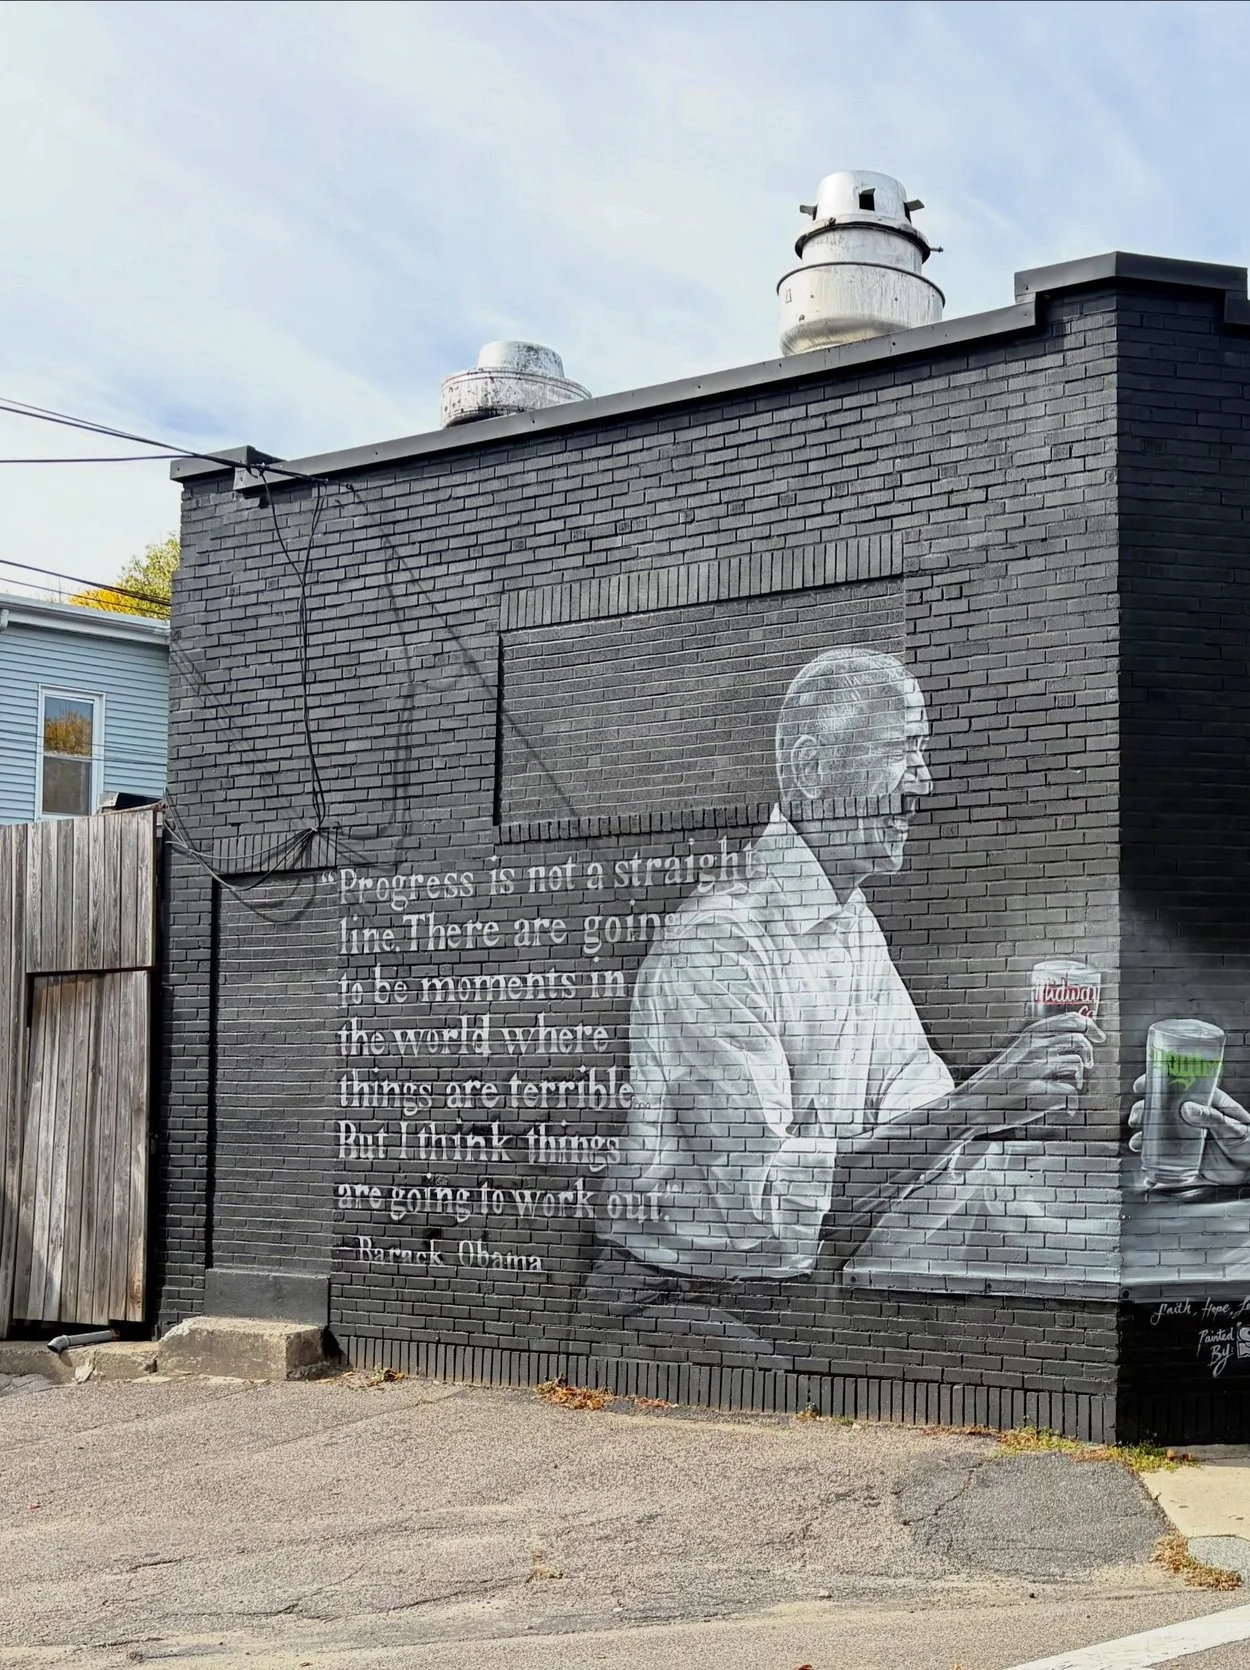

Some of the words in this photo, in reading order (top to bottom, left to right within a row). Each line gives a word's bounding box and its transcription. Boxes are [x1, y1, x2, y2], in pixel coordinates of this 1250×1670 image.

[489, 855, 516, 895] is
[527, 855, 576, 891] not
[585, 861, 605, 890] a
[614, 834, 757, 894] straight
[513, 918, 568, 947] are
[581, 900, 682, 954] going
[337, 971, 363, 1010] to
[374, 963, 408, 1004] be
[420, 968, 577, 1003] moments
[590, 956, 626, 999] in
[338, 1016, 386, 1056] the
[393, 1012, 492, 1056] world
[501, 1012, 610, 1055] where
[339, 1066, 433, 1116] things
[445, 1077, 499, 1109] are
[338, 1119, 388, 1160] But
[399, 1119, 410, 1160] I
[415, 1117, 513, 1161] think
[525, 1119, 622, 1173] things
[337, 1179, 383, 1213] are
[390, 1172, 471, 1223] going
[477, 1181, 504, 1215] to
[512, 1178, 599, 1219] work
[457, 1240, 543, 1273] Obama
[1196, 1328, 1235, 1357] Painted
